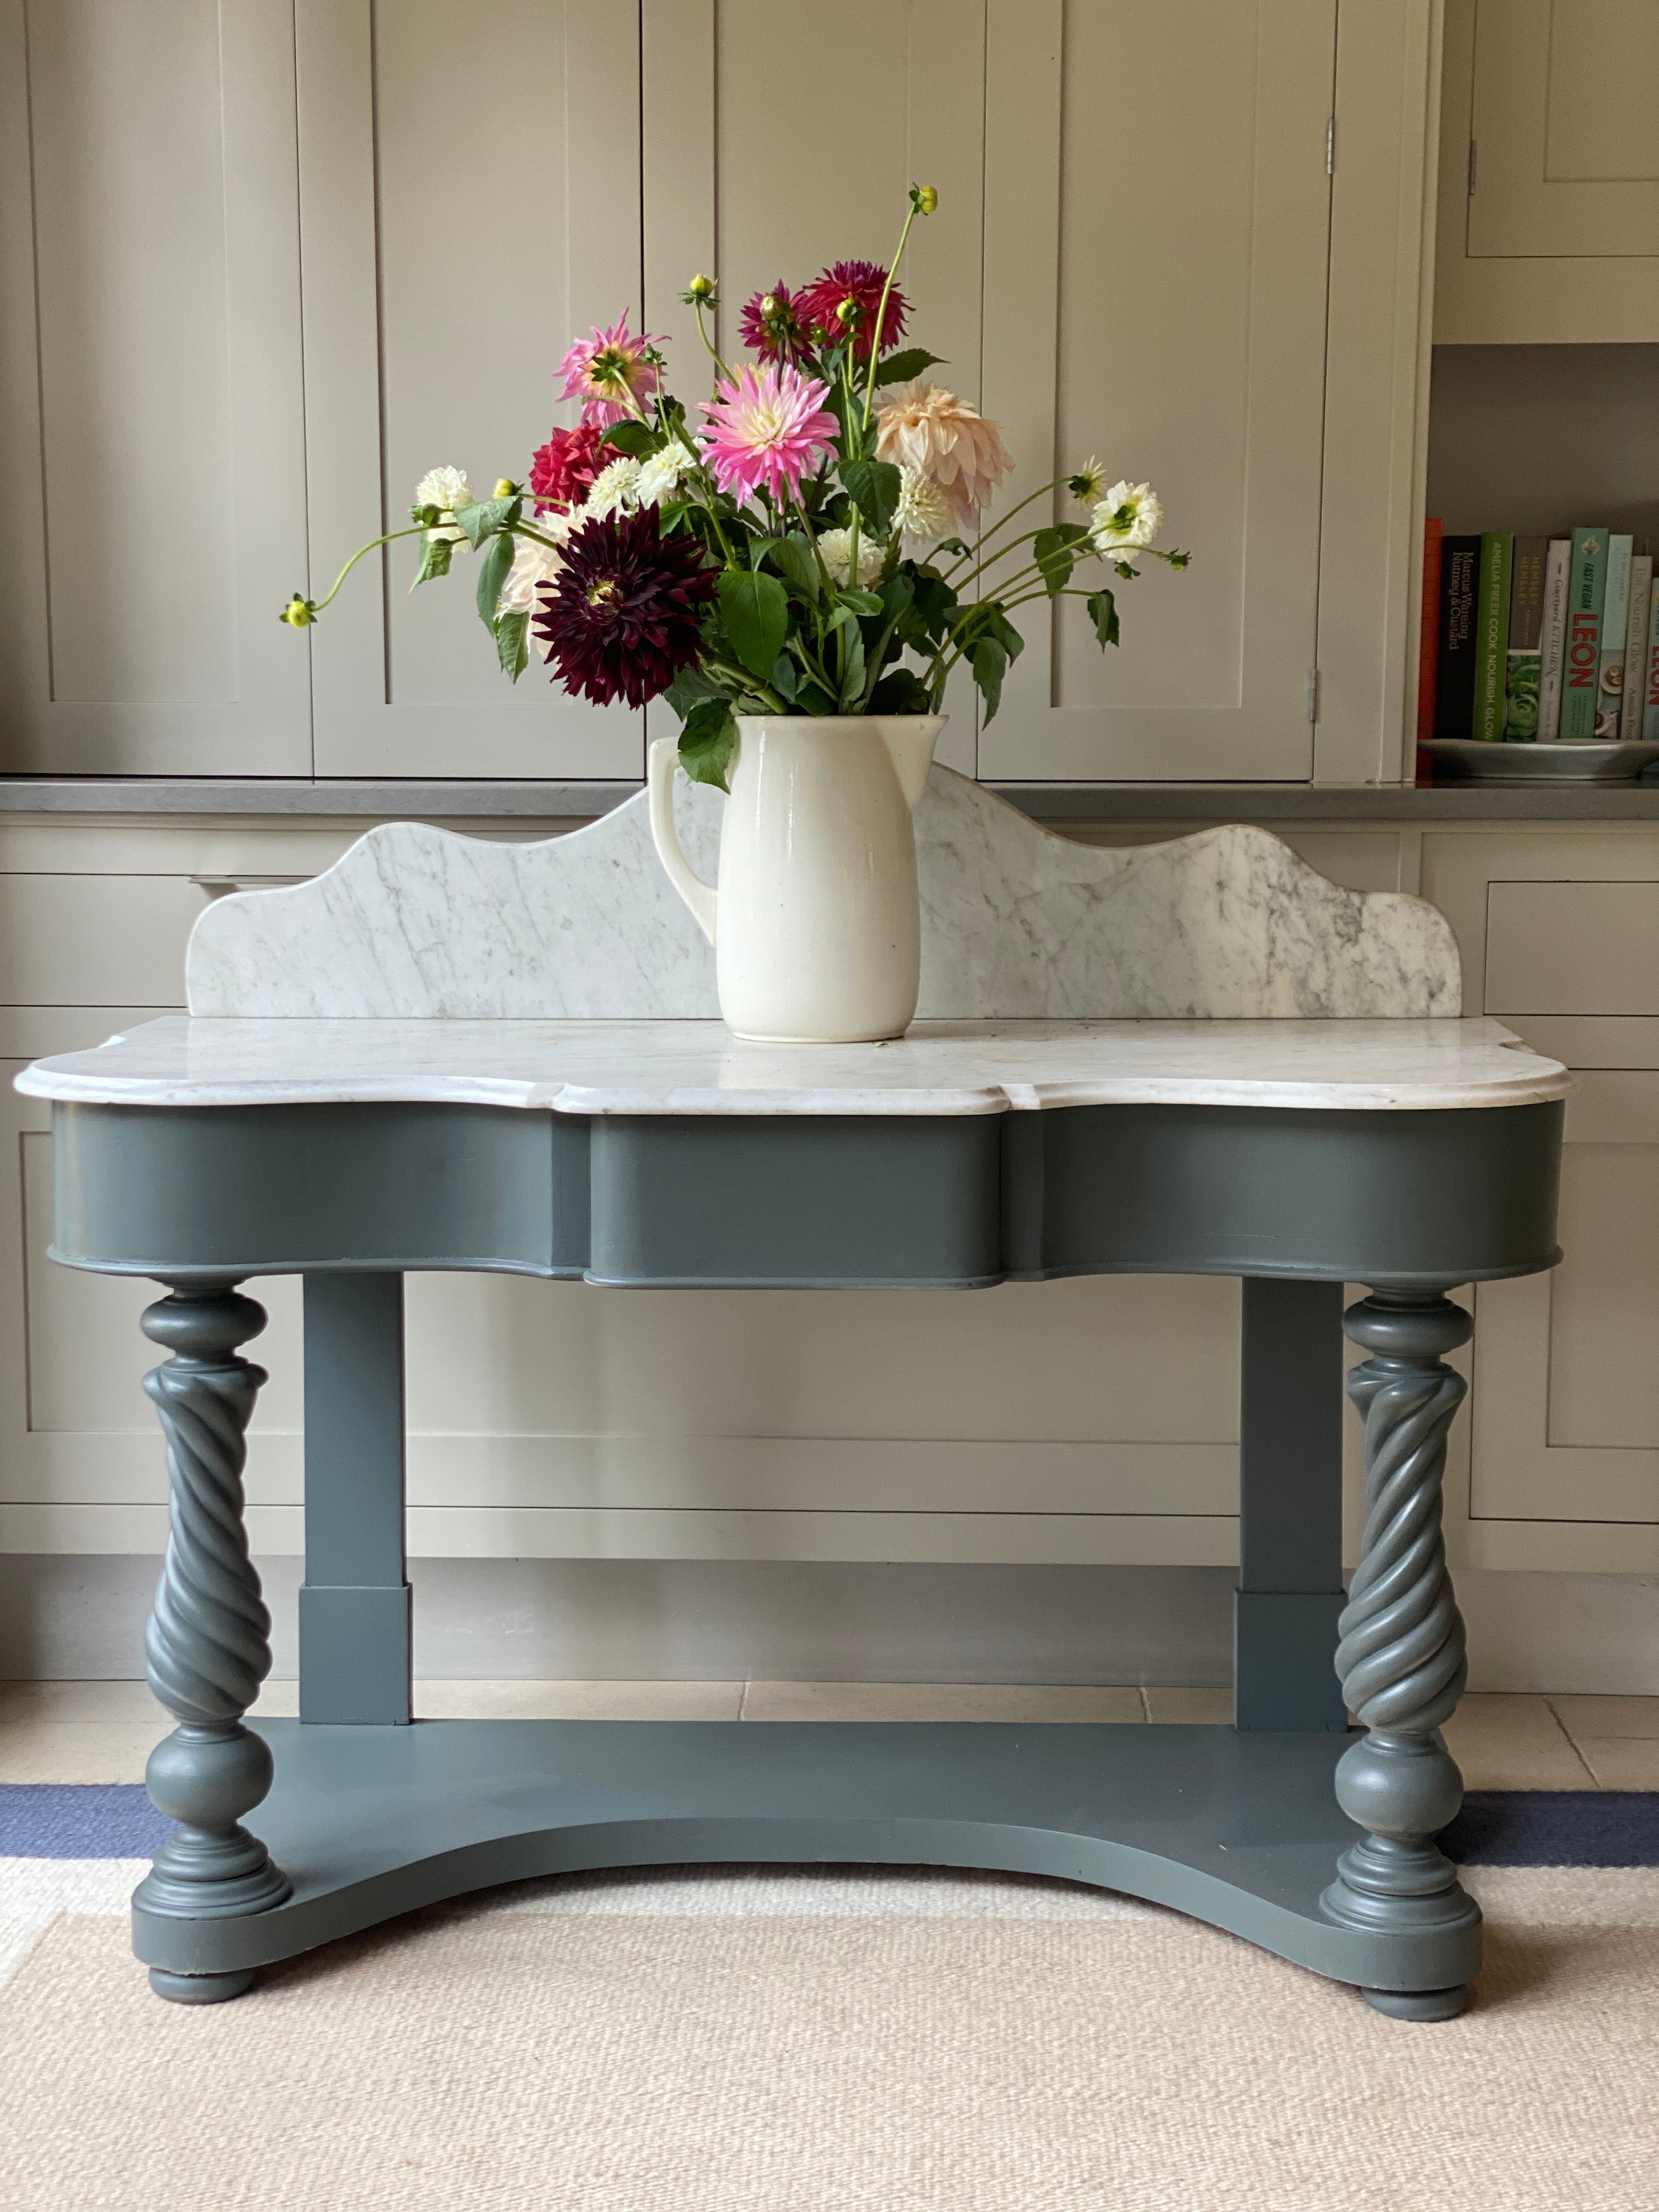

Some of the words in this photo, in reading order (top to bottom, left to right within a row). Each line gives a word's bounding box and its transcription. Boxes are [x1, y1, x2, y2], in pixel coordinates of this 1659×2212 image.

[1449, 552, 1463, 596] Nutmeg
[1462, 552, 1474, 592] Marcus
[1492, 542, 1502, 582] AMELIA
[1519, 556, 1529, 605] HEMSLEY
[1530, 556, 1541, 607] HEMSLEY
[1584, 563, 1595, 583] FAST
[1451, 597, 1461, 606] &
[1458, 592, 1472, 639] Wareing
[1491, 584, 1500, 616] FREER
[1553, 579, 1564, 623] Courtyard
[1582, 584, 1593, 610] VEGAN
[1449, 607, 1461, 650] Custard
[1568, 613, 1599, 687] LEON
[1547, 625, 1561, 676] KITCHEN
